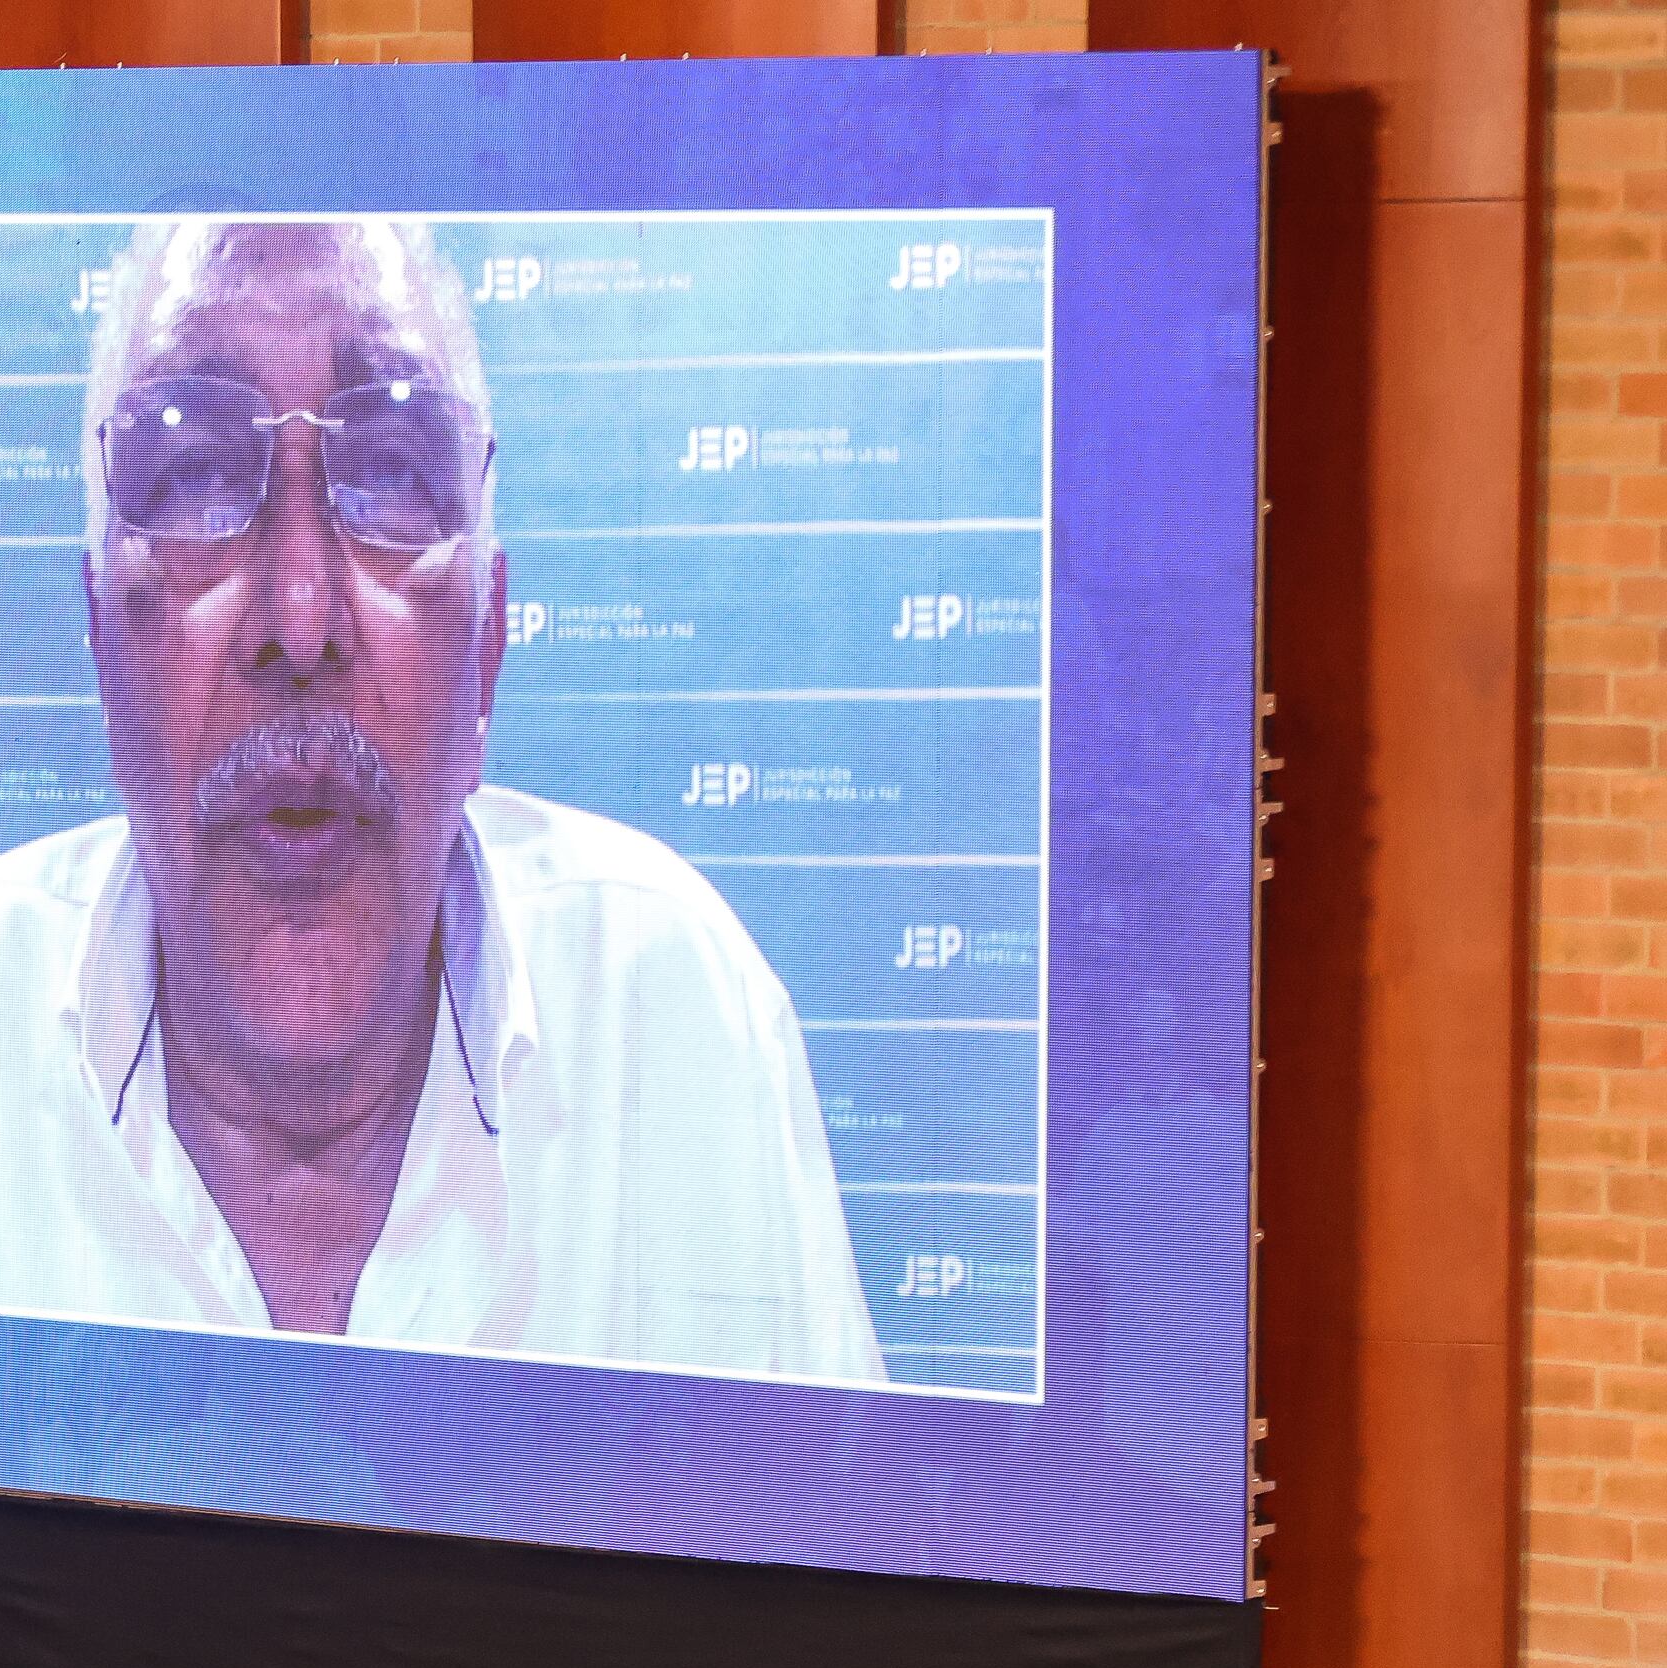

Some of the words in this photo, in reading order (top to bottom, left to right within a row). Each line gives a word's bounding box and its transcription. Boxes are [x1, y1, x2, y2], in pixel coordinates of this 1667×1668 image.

[475, 257, 541, 301] JEP
[890, 244, 961, 290] JEP
[72, 271, 112, 313] JE
[679, 425, 751, 471] JEP
[507, 602, 544, 643] EP
[892, 595, 964, 640] JEP
[683, 763, 751, 807] JEP
[895, 925, 962, 969] JEP
[896, 1255, 964, 1297] JEP
